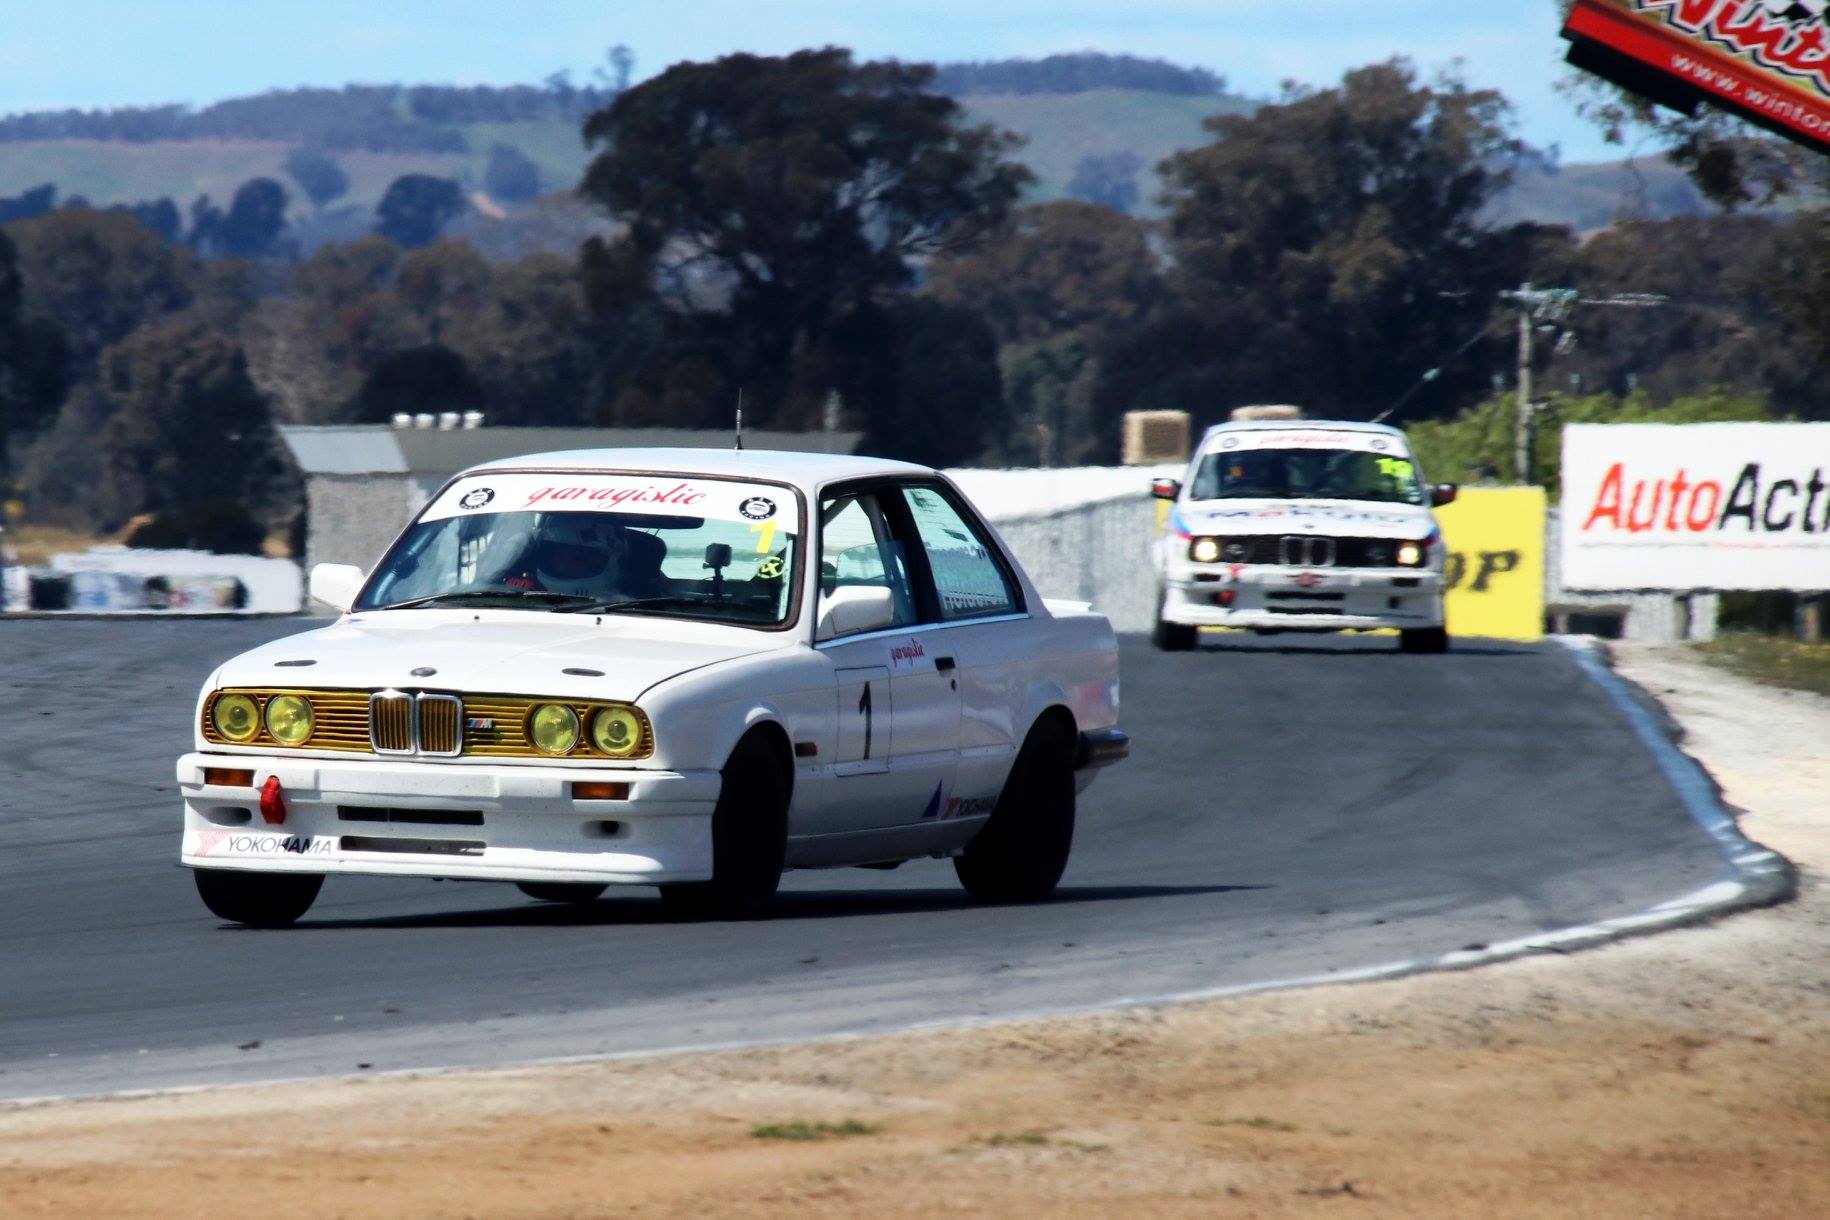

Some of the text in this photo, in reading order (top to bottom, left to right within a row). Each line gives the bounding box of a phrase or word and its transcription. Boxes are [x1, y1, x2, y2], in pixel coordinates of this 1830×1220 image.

[750, 520, 776, 554] 1
[859, 680, 872, 760] 1
[228, 835, 332, 855] YOKOHAMA
